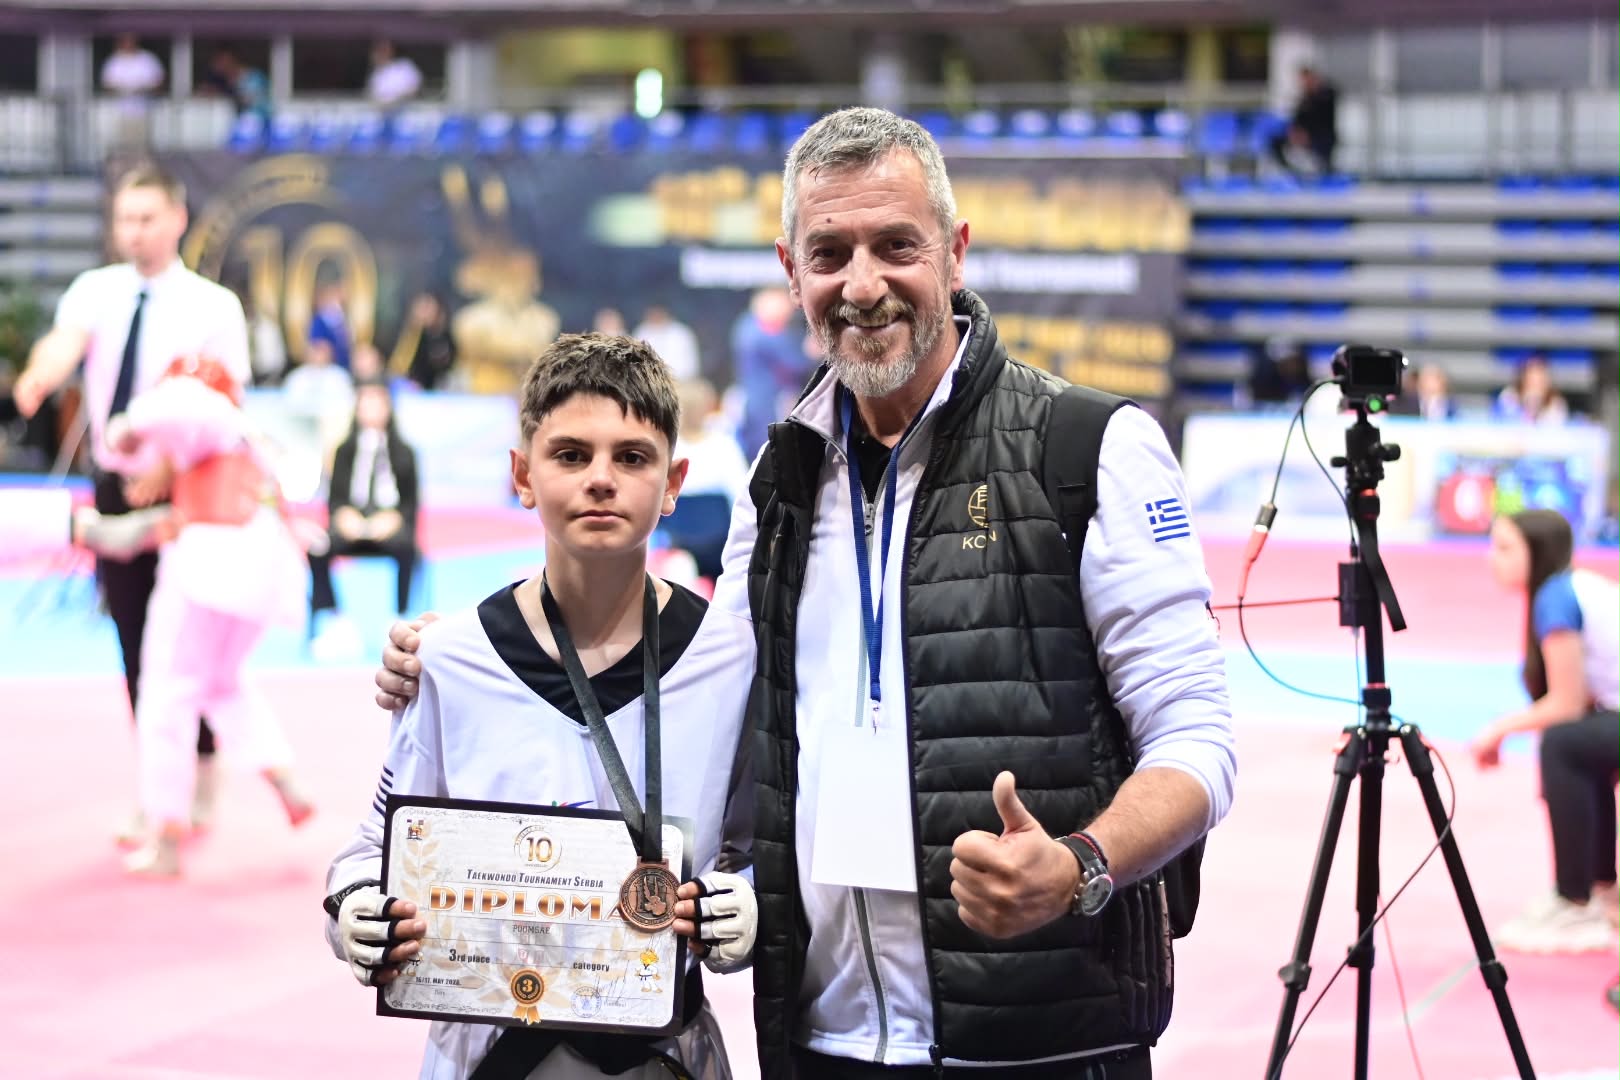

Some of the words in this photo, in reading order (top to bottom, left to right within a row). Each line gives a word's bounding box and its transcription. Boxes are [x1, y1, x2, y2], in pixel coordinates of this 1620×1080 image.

[526, 836, 553, 863] 10
[518, 872, 573, 887] TOURNAMENT
[573, 876, 604, 889] SERBIA
[449, 948, 466, 963] 3rd
[467, 953, 491, 965] place
[573, 960, 610, 973] category
[522, 978, 534, 993] 3
